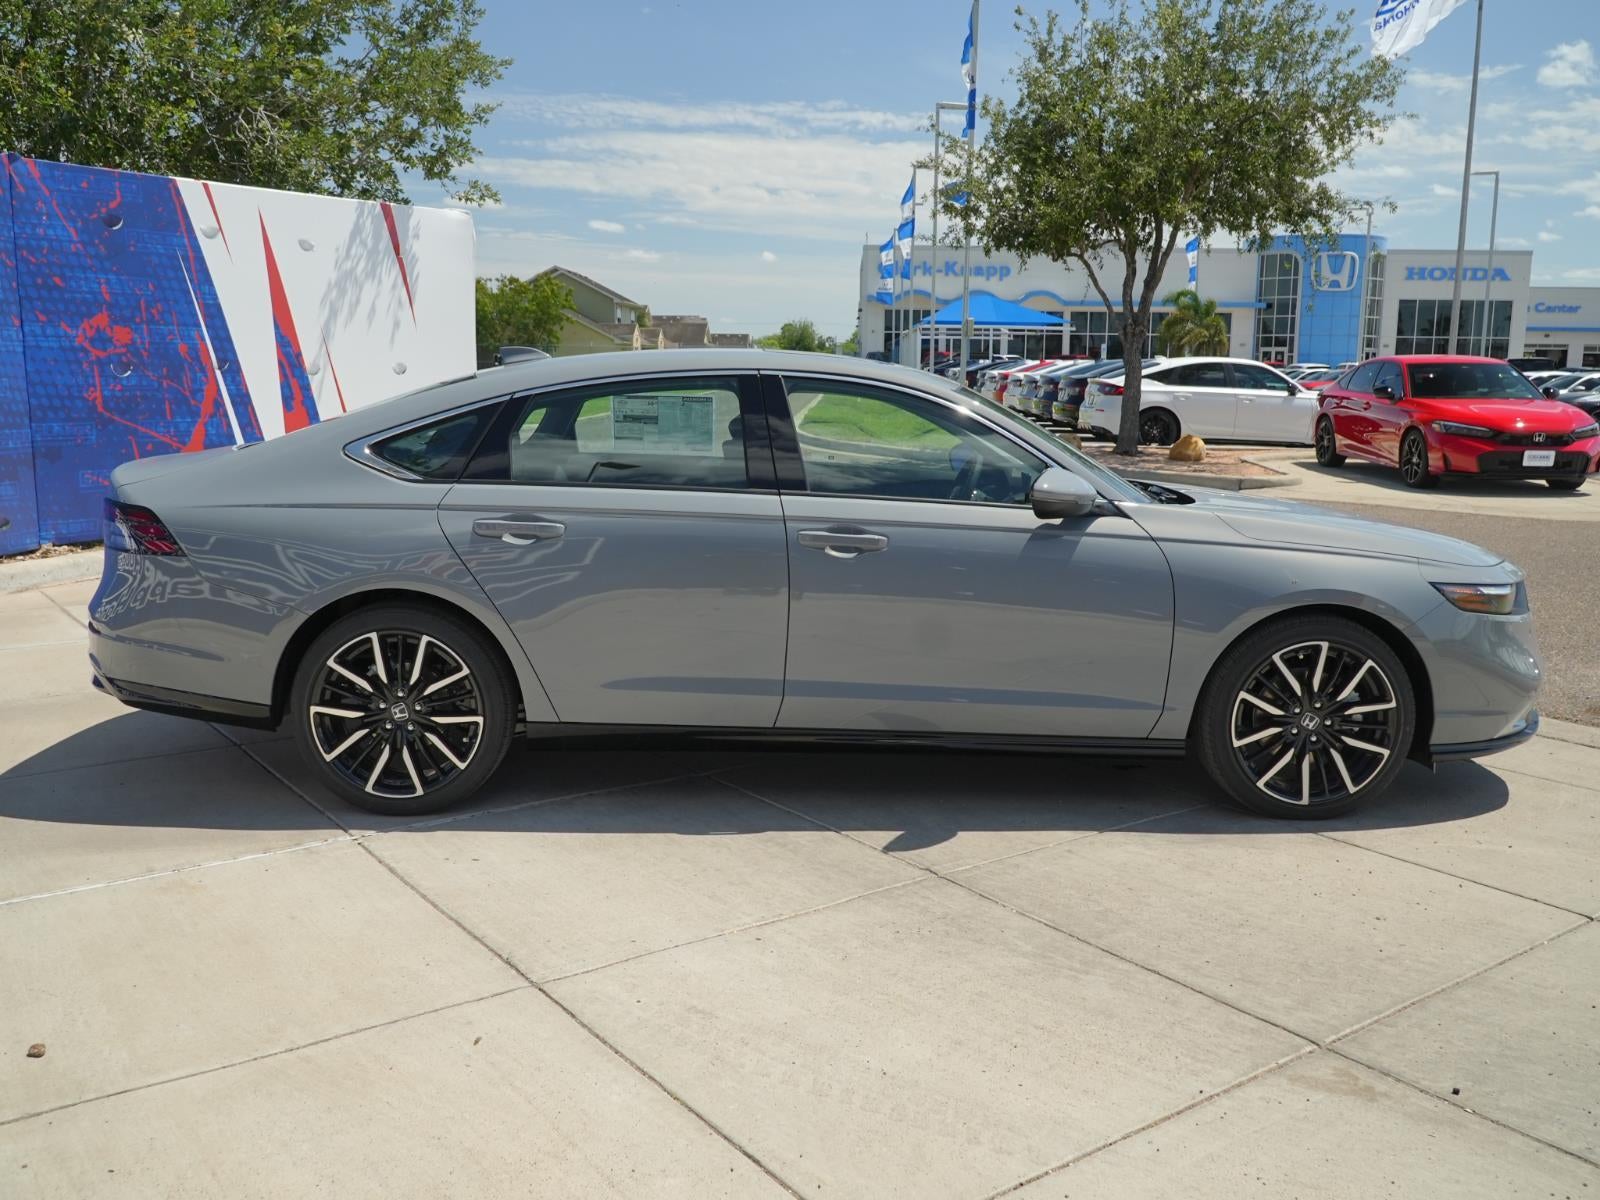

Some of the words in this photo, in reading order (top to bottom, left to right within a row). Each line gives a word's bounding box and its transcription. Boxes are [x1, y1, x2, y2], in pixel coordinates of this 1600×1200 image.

[877, 260, 1011, 281] lrk-Knapp
[1405, 267, 1511, 281] HONDA
[1534, 302, 1581, 314] Center
